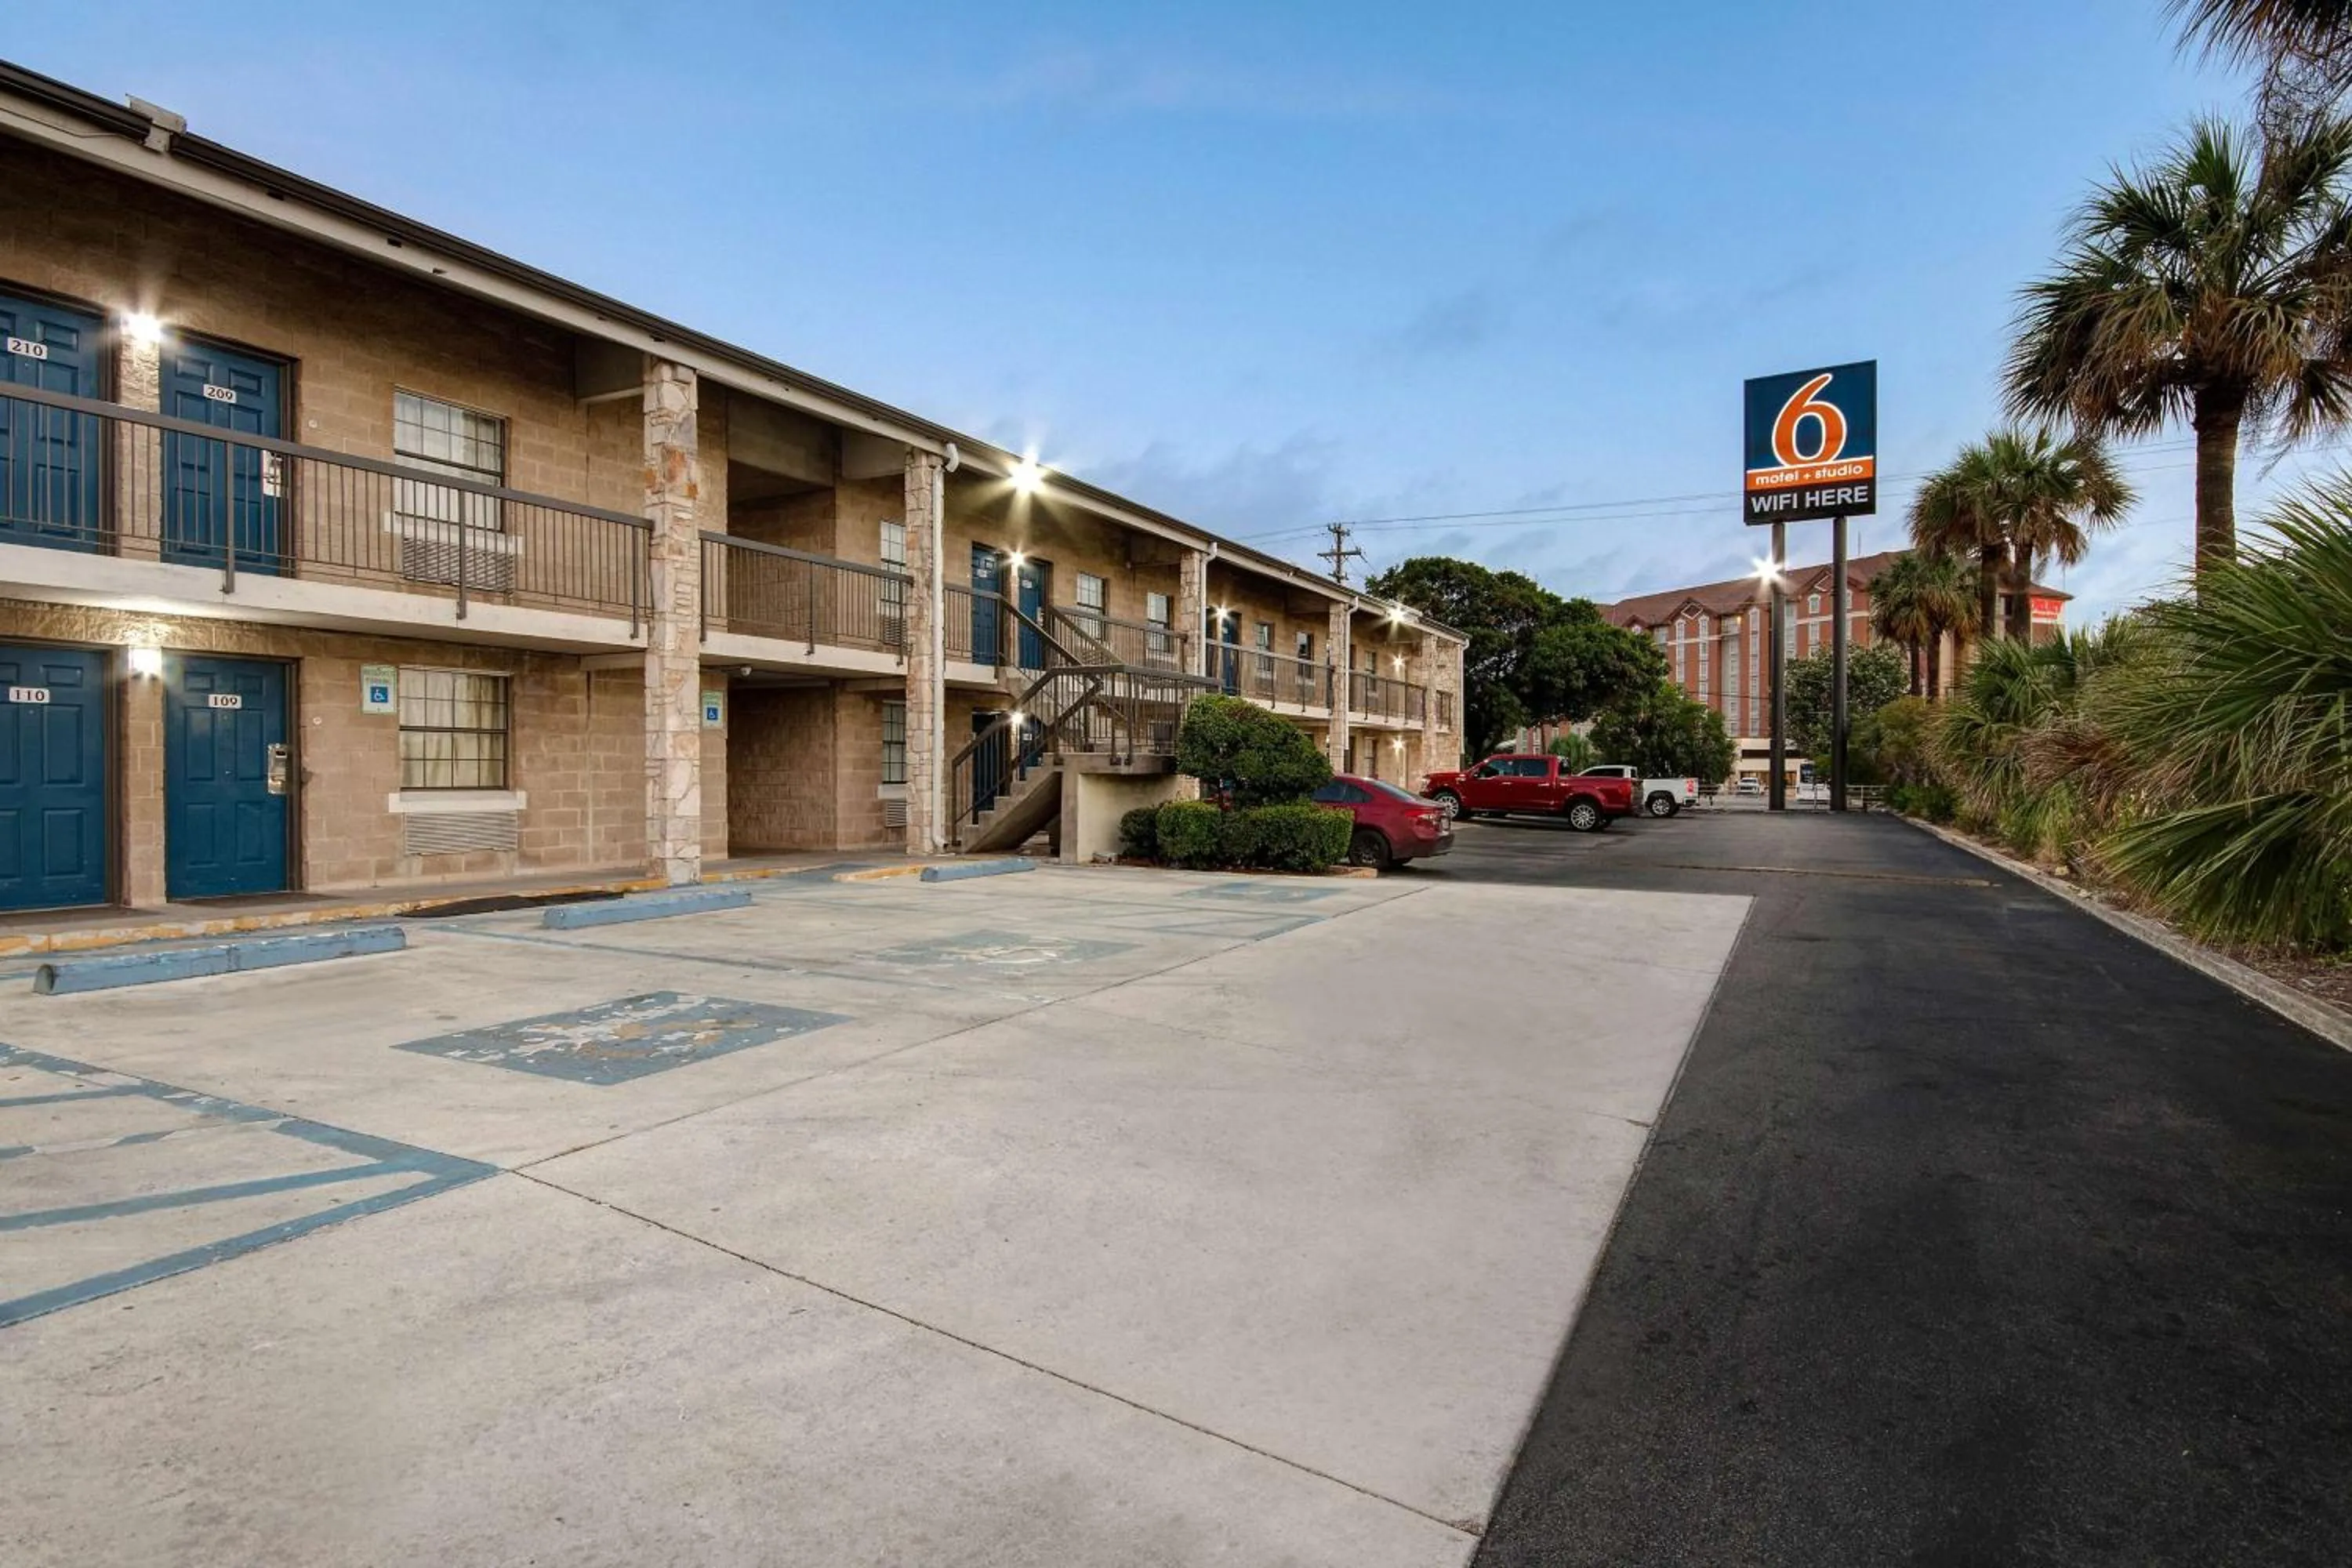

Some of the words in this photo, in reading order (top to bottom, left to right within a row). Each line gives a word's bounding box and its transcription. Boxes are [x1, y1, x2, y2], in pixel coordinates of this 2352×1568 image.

[12, 339, 43, 357] 210
[208, 387, 233, 400] 209
[1772, 372, 1847, 468] 6
[1755, 472, 1798, 485] motel
[1815, 464, 1864, 479] studio
[1751, 492, 1798, 514] WIFI
[1805, 485, 1869, 509] HERE
[16, 689, 45, 702] 110
[213, 695, 238, 706] 109
